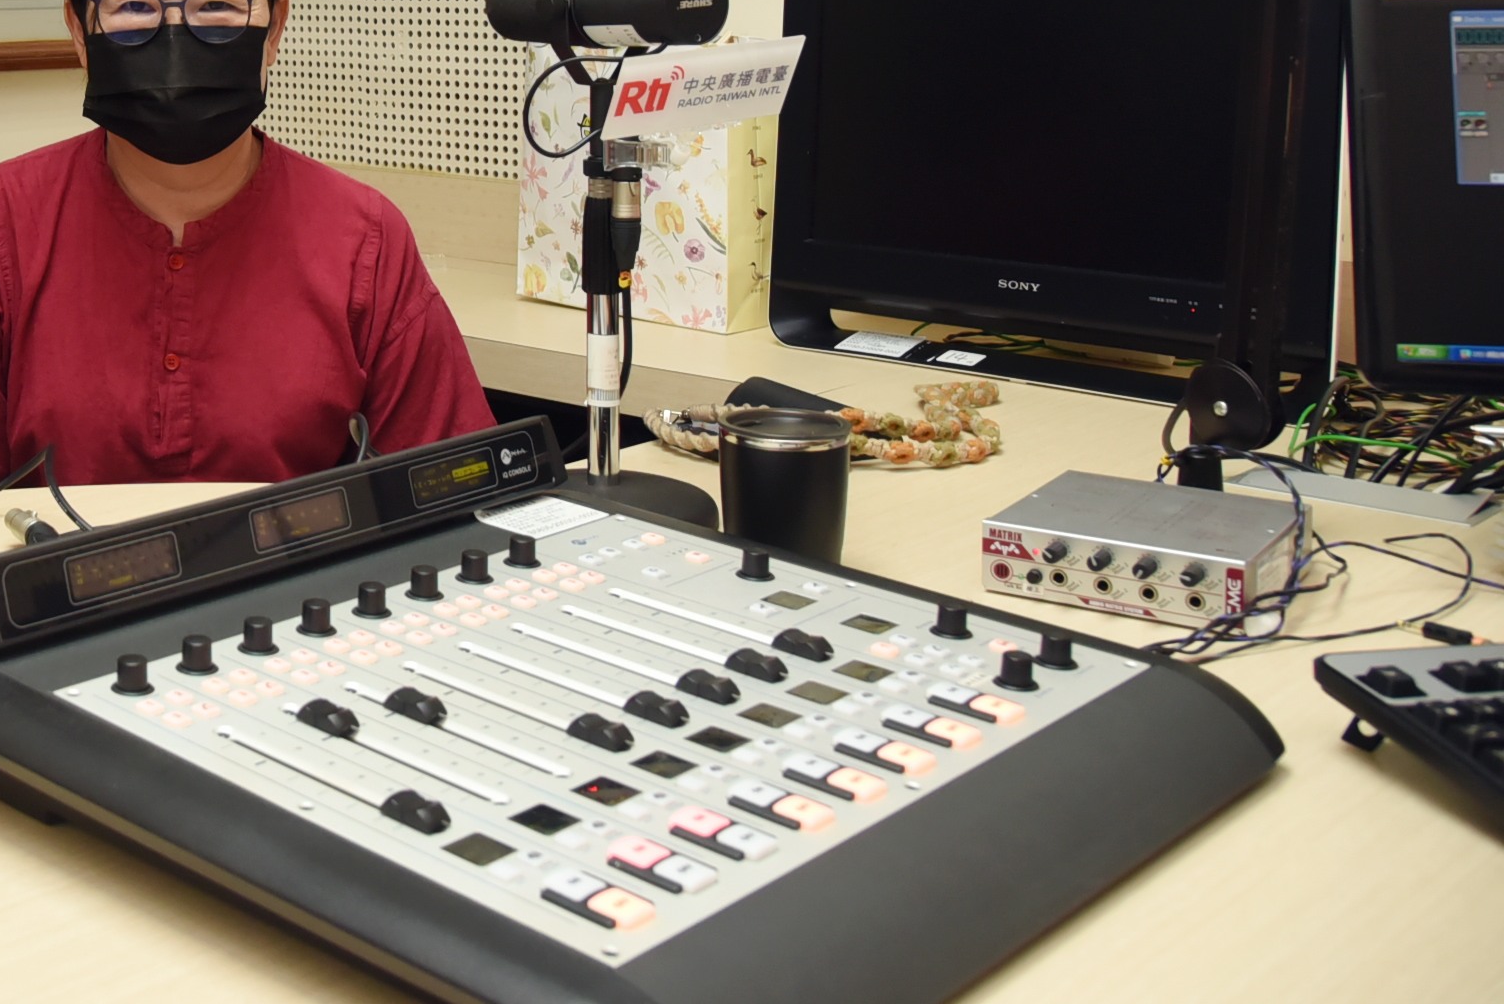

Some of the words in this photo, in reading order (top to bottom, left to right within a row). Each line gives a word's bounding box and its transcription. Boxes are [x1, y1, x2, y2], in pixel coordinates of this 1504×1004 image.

[682, 64, 790, 95] 中央廣播電臺
[614, 76, 673, 117] Rti
[677, 95, 713, 109] RADIO
[715, 90, 757, 105] TAIWAN
[758, 85, 782, 98] INTL
[997, 278, 1041, 293] SONY
[989, 528, 1023, 543] MATRIX
